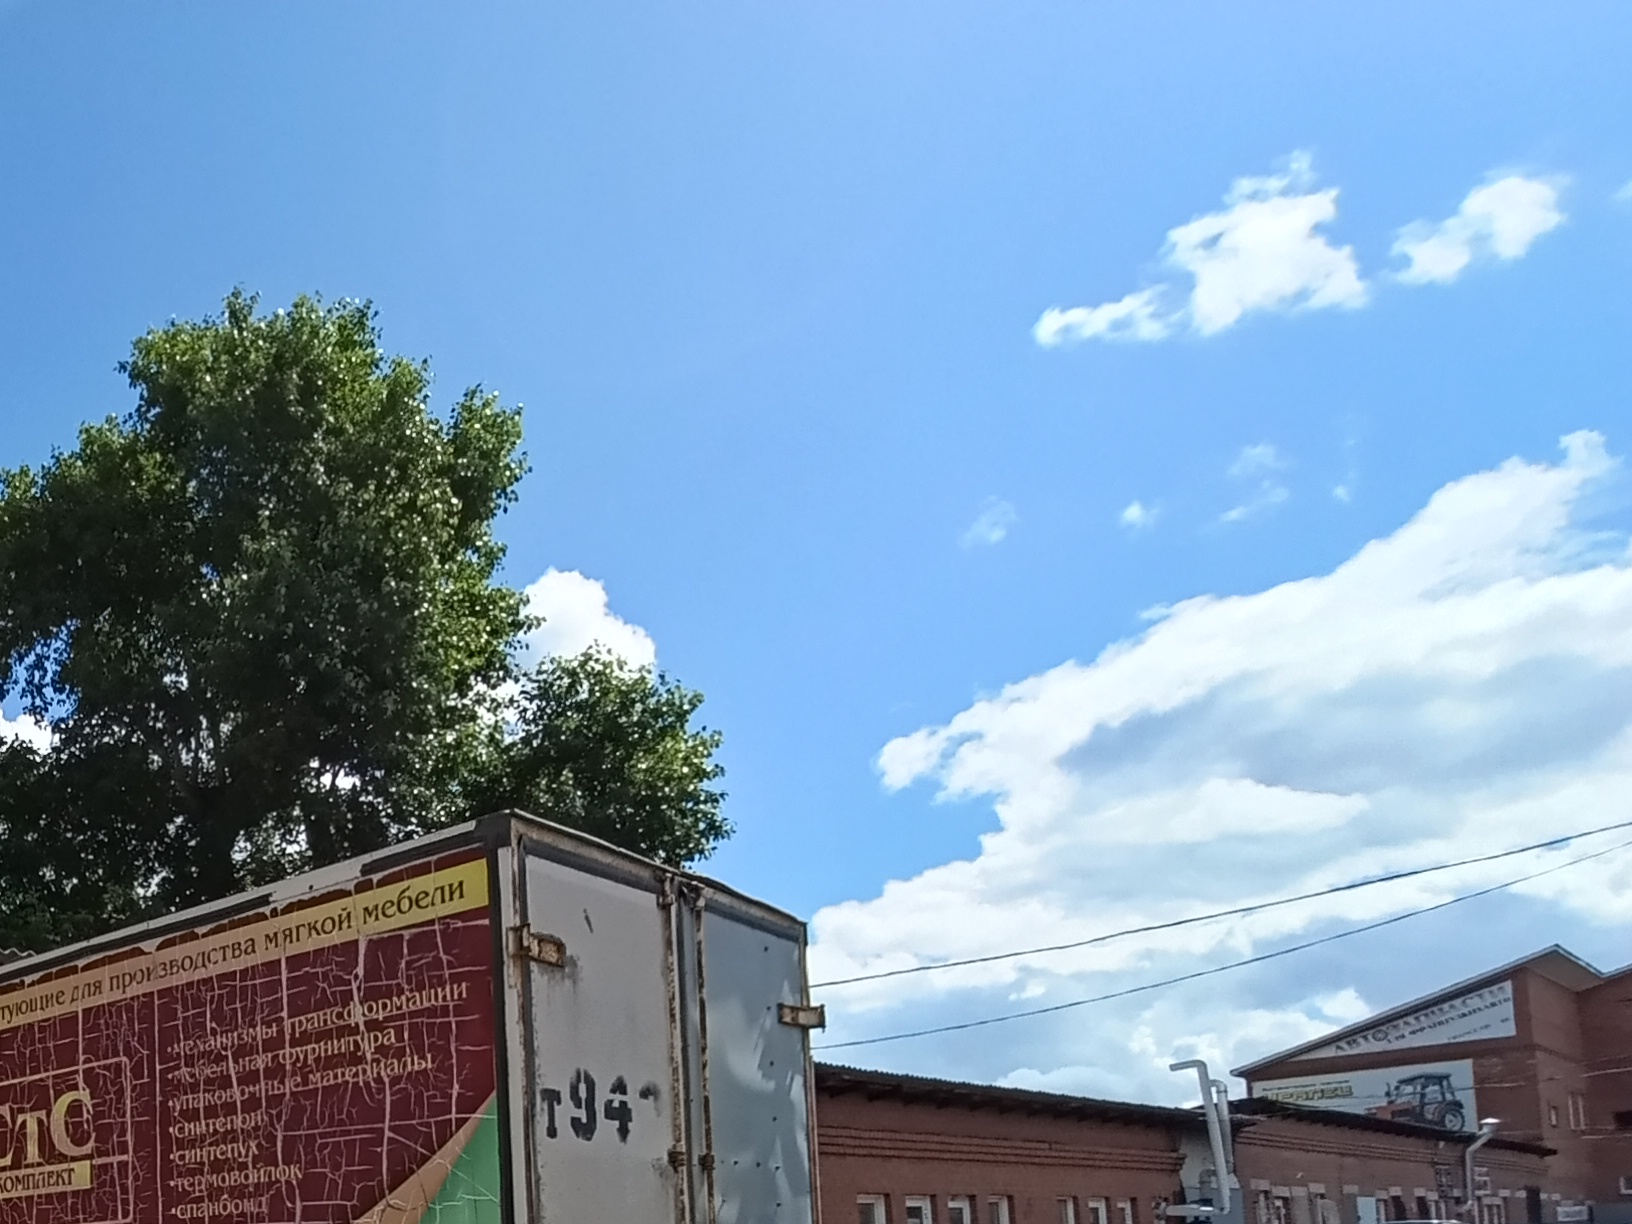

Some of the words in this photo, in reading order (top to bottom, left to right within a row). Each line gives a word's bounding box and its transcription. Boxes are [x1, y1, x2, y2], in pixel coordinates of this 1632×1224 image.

[69, 979, 103, 1004] для
[109, 938, 256, 994] производства
[264, 908, 352, 951] мягкой
[362, 879, 465, 925] мебели
[172, 1024, 278, 1056] механизмы
[284, 981, 468, 1037] трансформации
[173, 1054, 273, 1083] мебельная
[279, 1028, 397, 1068] фурнитура
[172, 1074, 302, 1113] упаковочные
[308, 1054, 434, 1085] материалы
[174, 1109, 262, 1137] синтепон
[175, 1139, 259, 1164] синтепух
[176, 1163, 303, 1195] термовойлок
[176, 1195, 268, 1218] спанбонд
